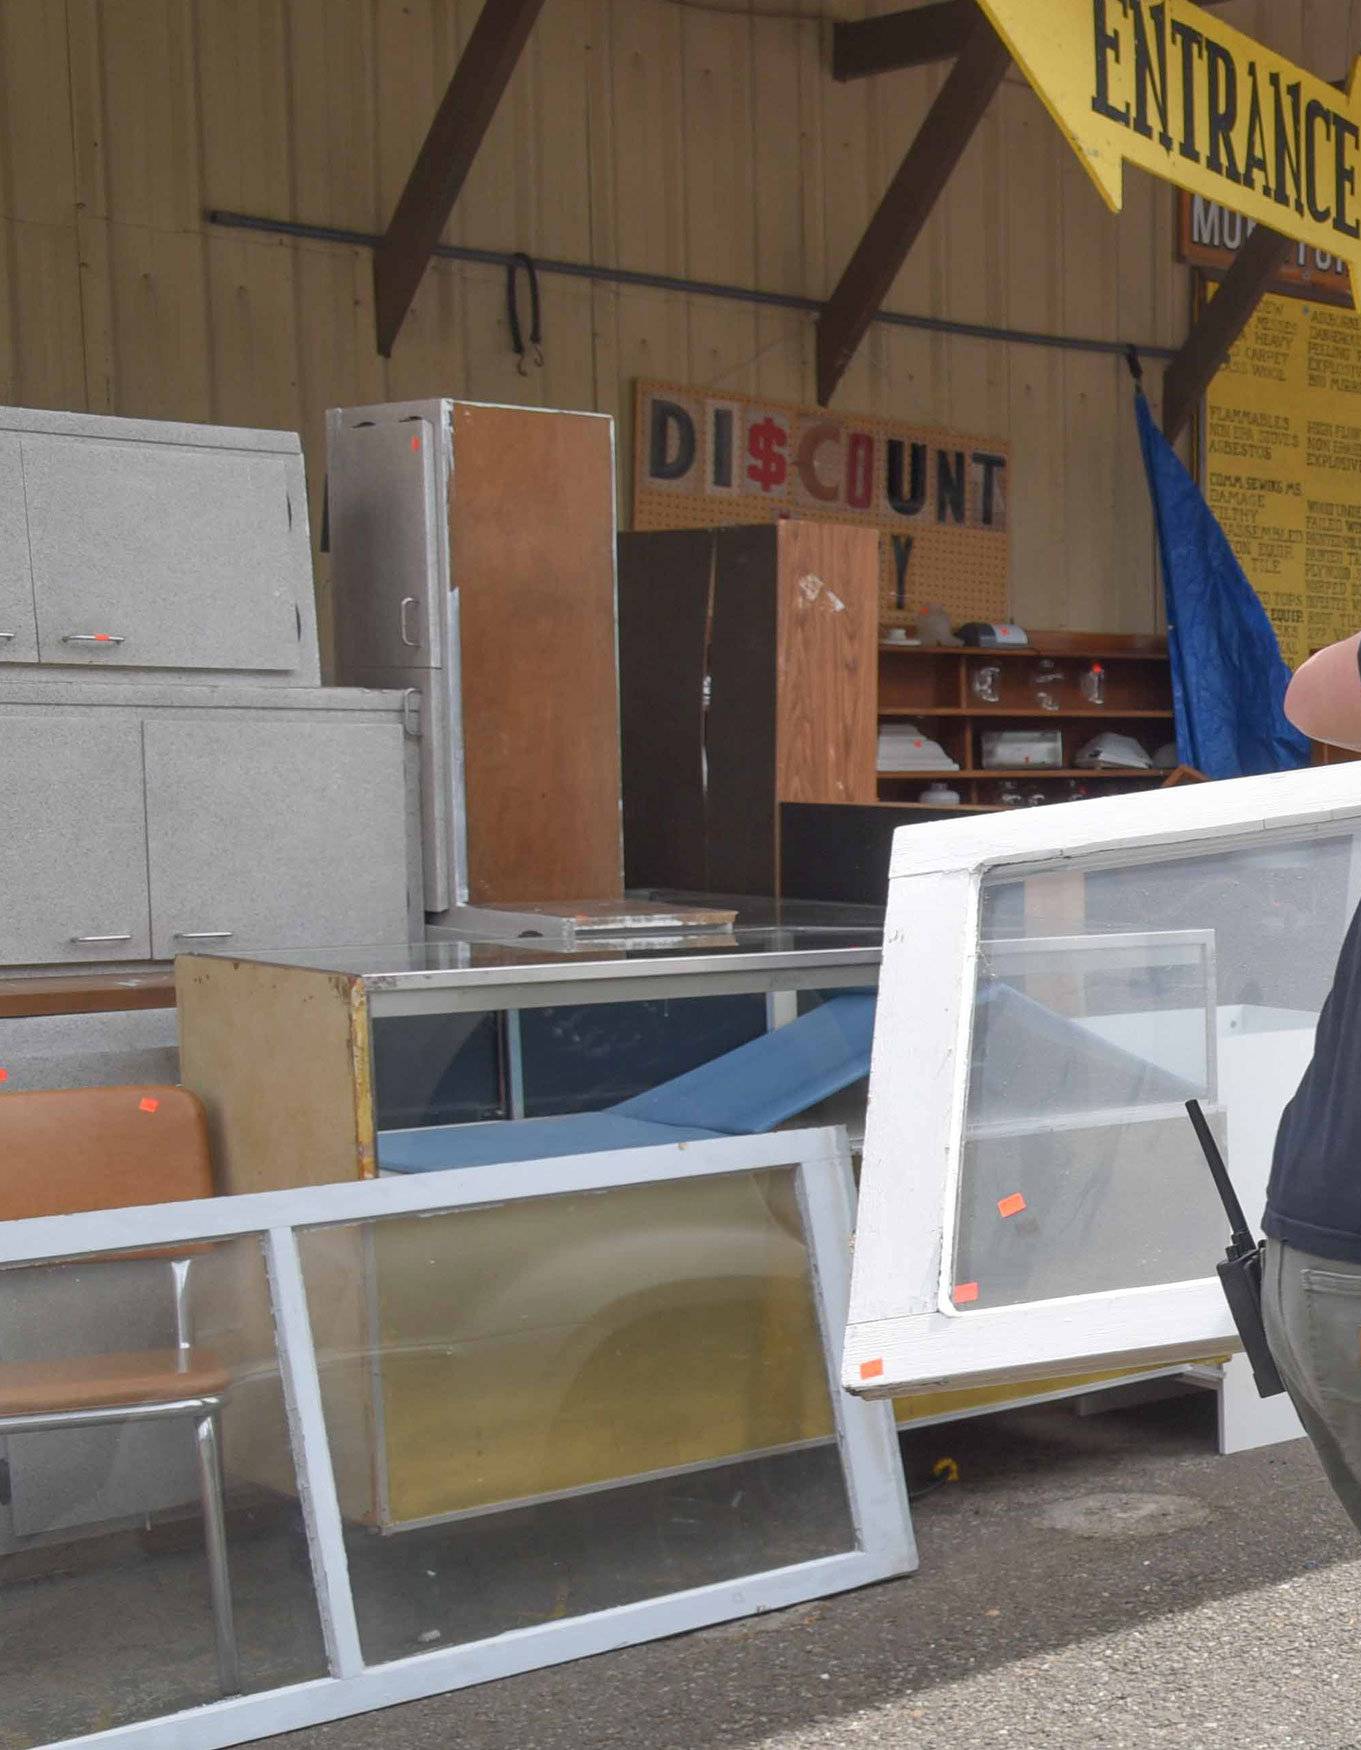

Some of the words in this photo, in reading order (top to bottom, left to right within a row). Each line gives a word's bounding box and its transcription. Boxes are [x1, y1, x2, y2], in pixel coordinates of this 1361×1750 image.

[1092, 0, 1360, 239] ENTRANCE
[1209, 405, 1289, 430] FLAMMABLES
[1209, 440, 1271, 460] ASBESTOS
[1307, 437, 1330, 452] NON
[1210, 489, 1265, 508] DAMAGE
[1251, 558, 1280, 574] TILE
